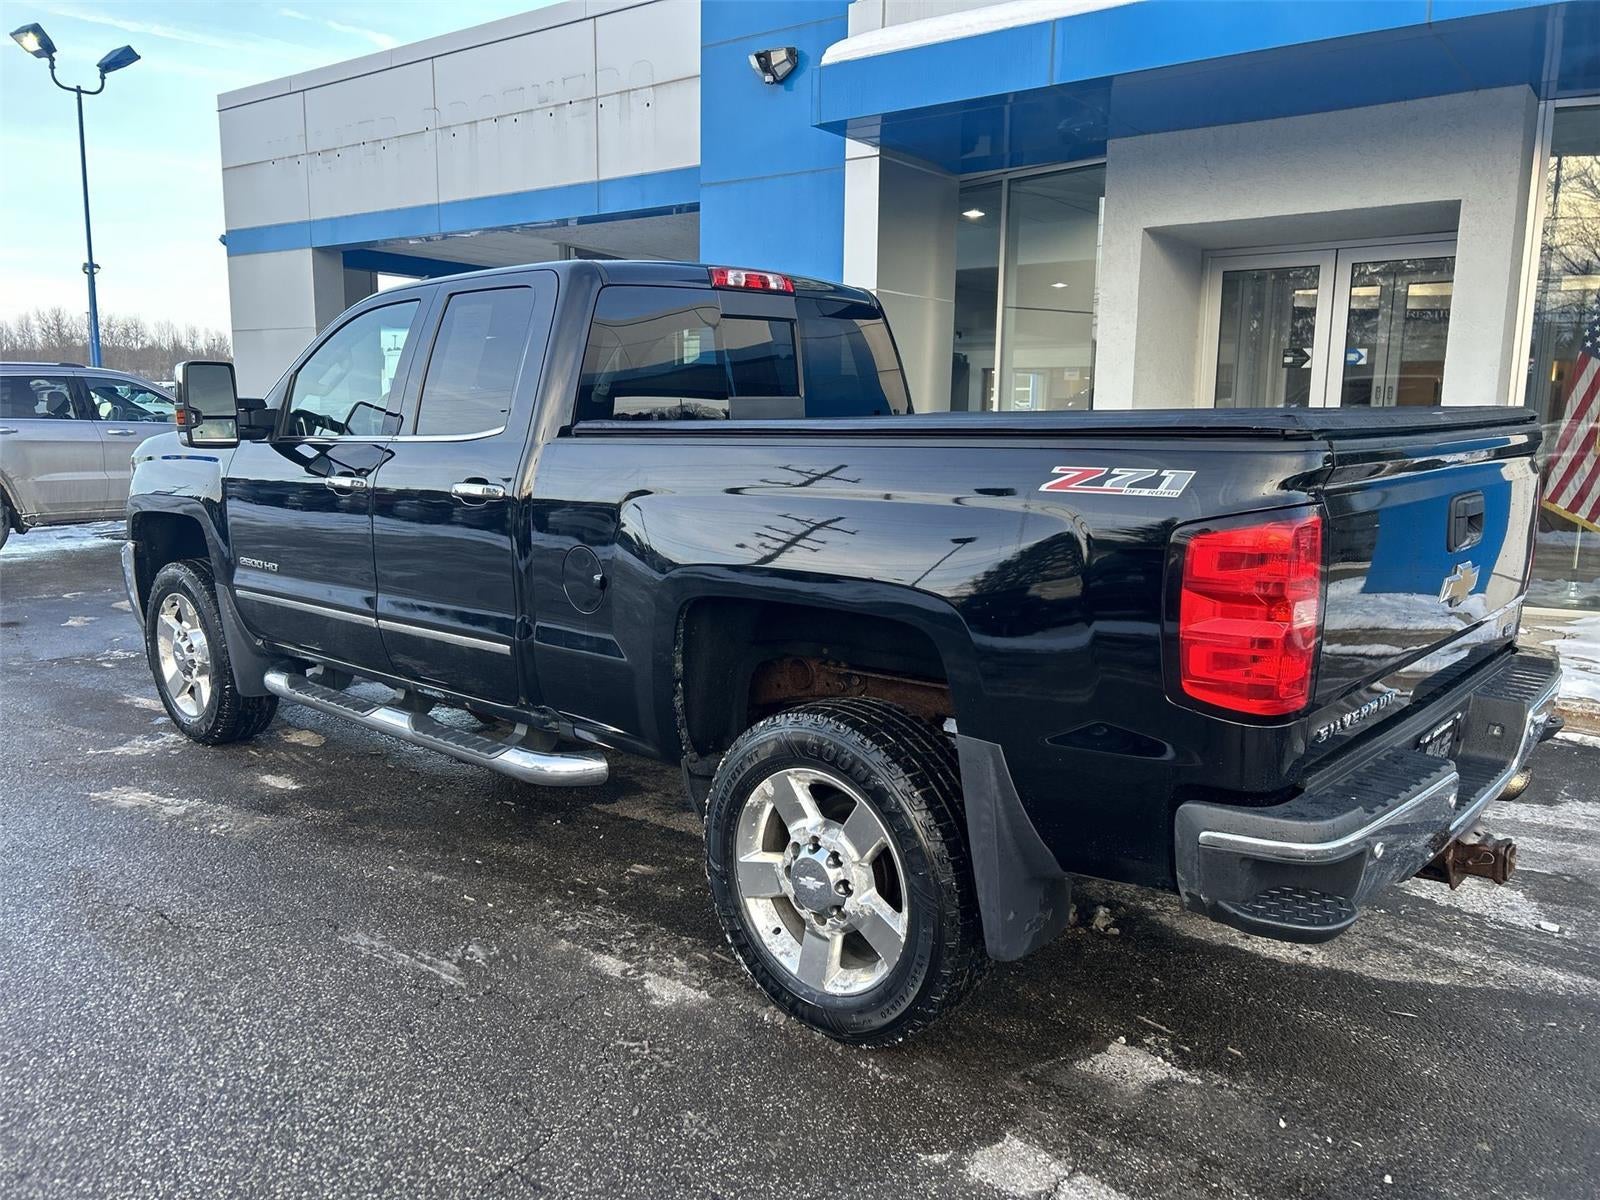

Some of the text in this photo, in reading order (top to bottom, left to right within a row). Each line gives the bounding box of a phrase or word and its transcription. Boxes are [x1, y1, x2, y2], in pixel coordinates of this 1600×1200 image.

[1038, 466, 1197, 494] Z71
[1148, 489, 1180, 497] ROAD
[240, 557, 279, 572] 2500 HD
[713, 761, 746, 830] WORKHORSE
